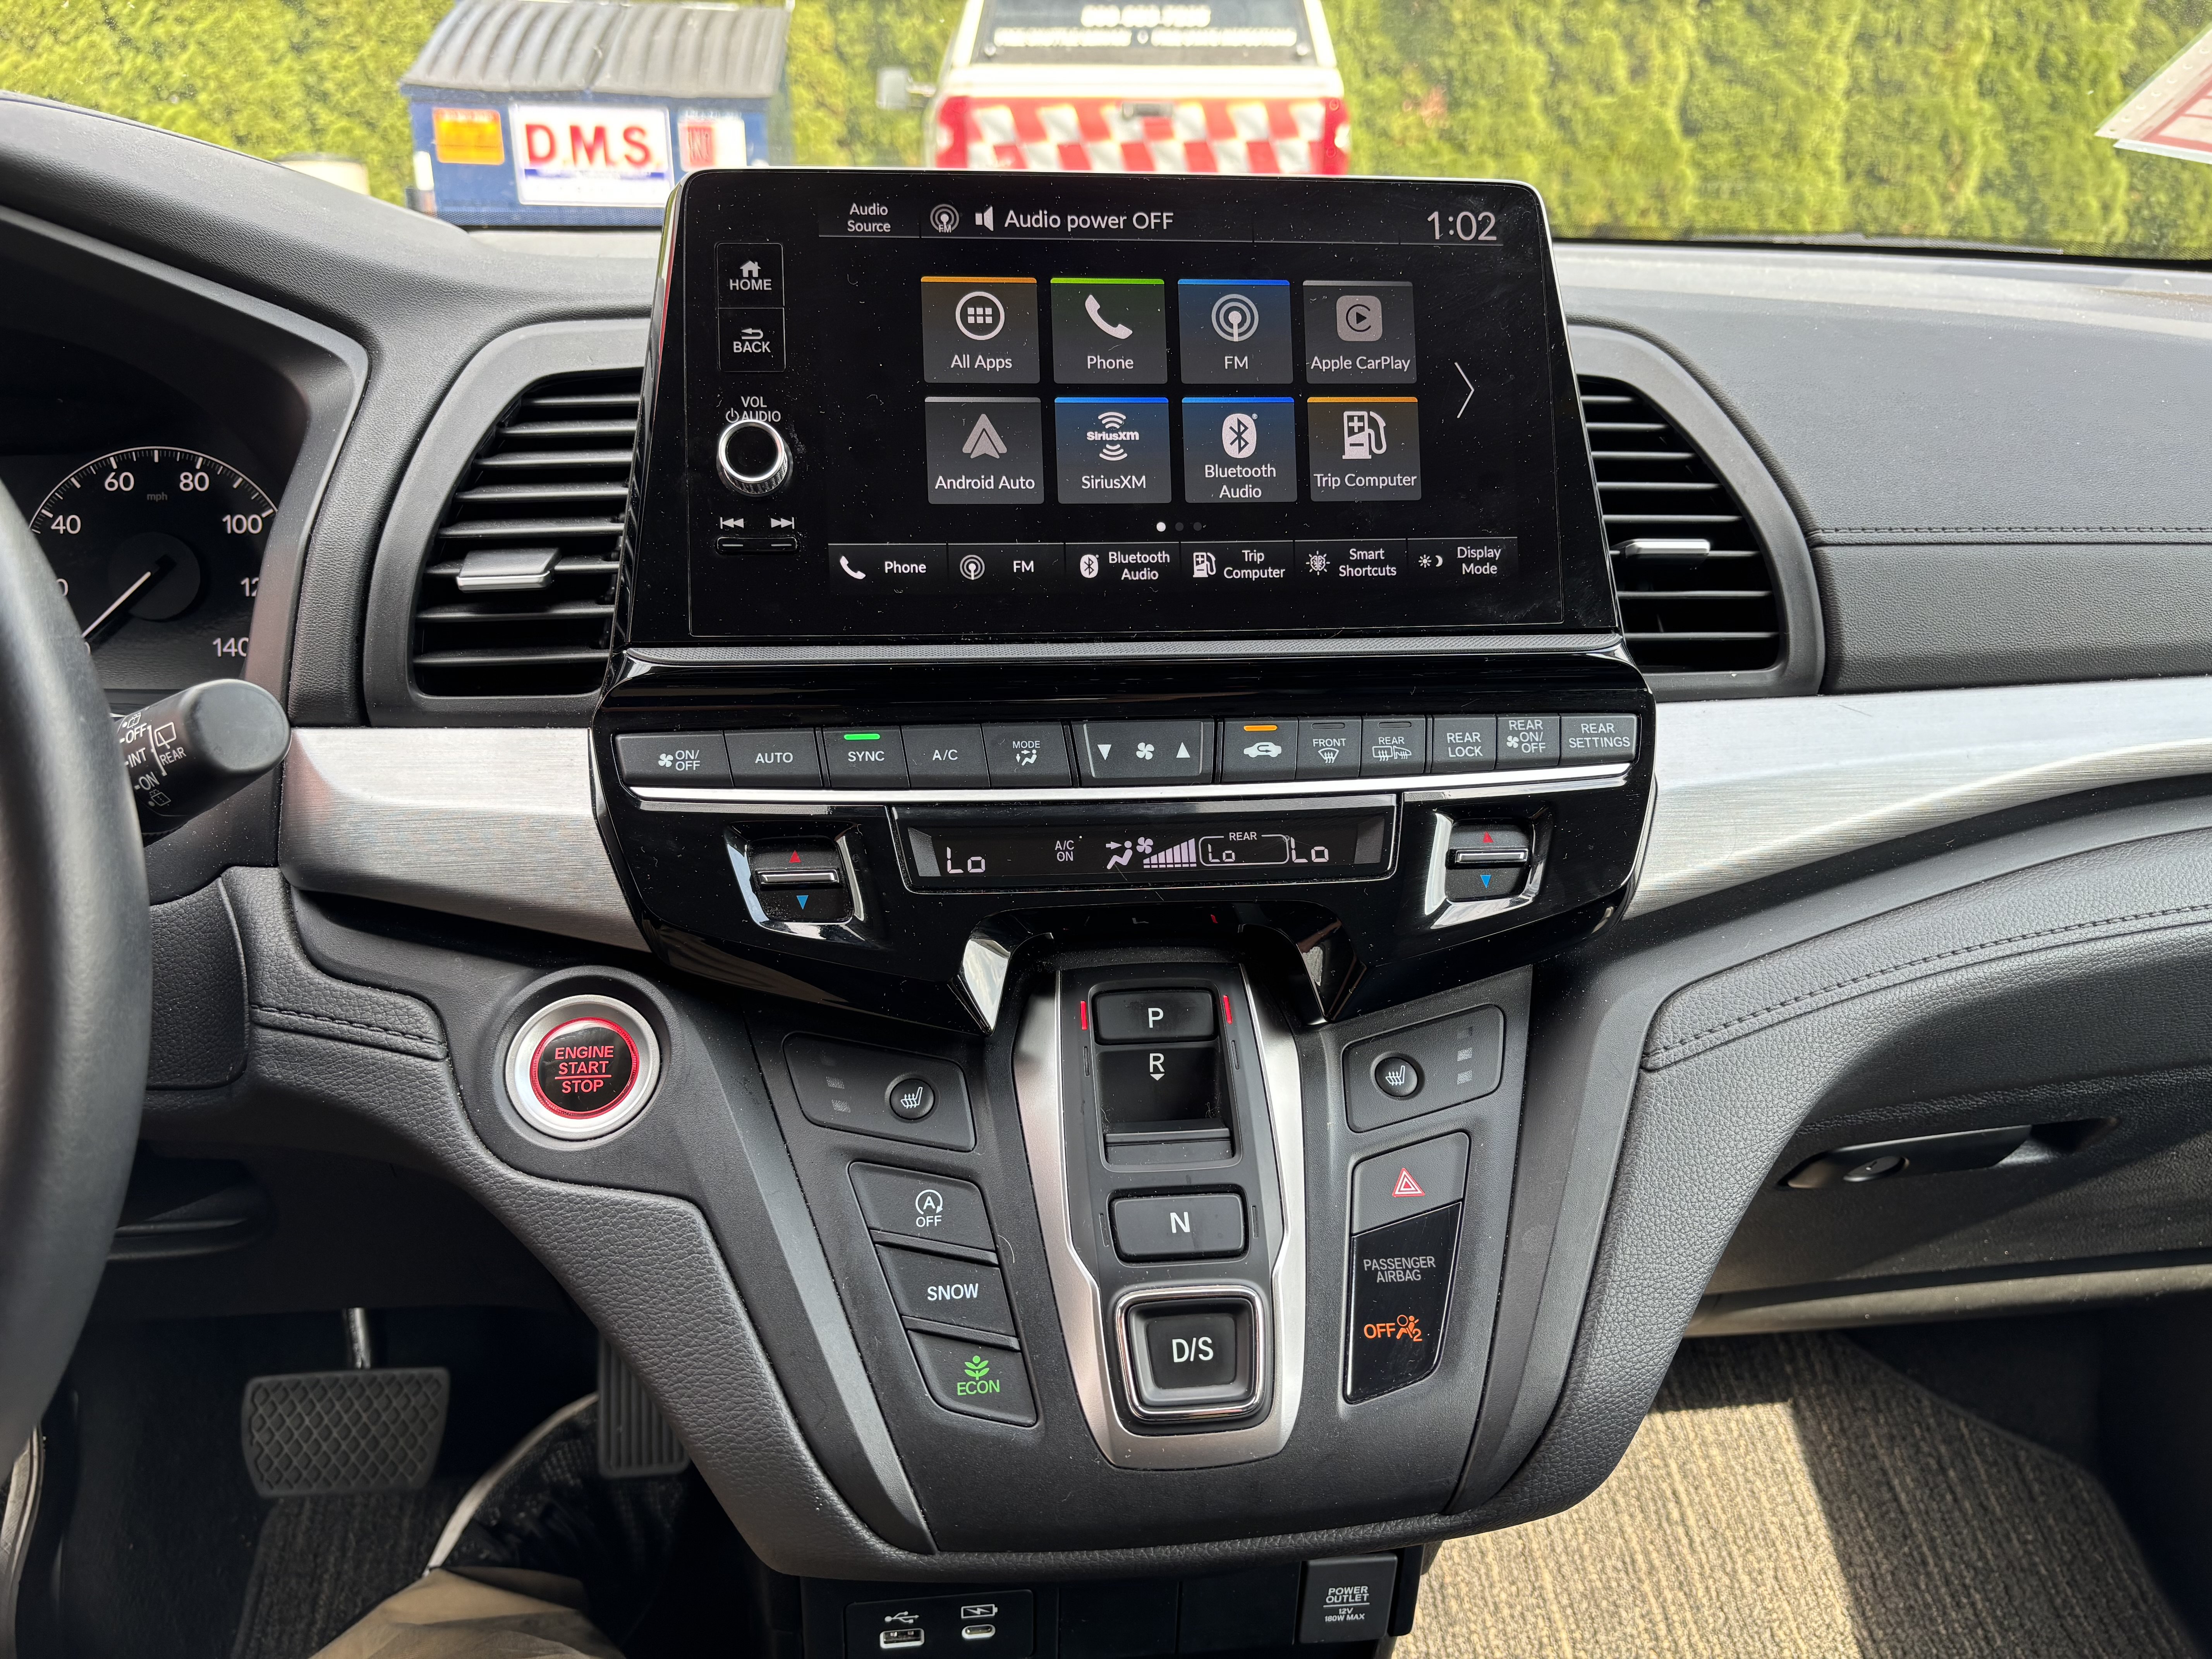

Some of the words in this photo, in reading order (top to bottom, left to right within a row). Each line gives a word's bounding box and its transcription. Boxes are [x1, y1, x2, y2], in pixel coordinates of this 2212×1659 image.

[850, 203, 888, 215] Audio
[847, 220, 891, 232] Source
[1004, 210, 1061, 228] Audio
[1067, 215, 1127, 232] power
[1133, 212, 1174, 230] OFF
[1427, 211, 1497, 240] 1:02
[730, 279, 772, 290] HOME
[733, 341, 771, 353] BACK
[951, 354, 970, 368] All
[974, 355, 1012, 372] Apps
[1087, 355, 1133, 369] Phone
[1224, 356, 1248, 369] FM
[1310, 356, 1352, 372] Apple
[1356, 356, 1410, 372] CarPlay
[741, 396, 767, 407] VOL
[742, 411, 781, 422] AUDIO
[1205, 464, 1276, 478] Bluetooth
[105, 472, 134, 491] 60
[179, 472, 209, 491] 80
[935, 475, 994, 489] Android
[998, 476, 1035, 489] Auto
[1082, 475, 1146, 489] SiriusXM
[1313, 473, 1341, 489] Trip
[1345, 474, 1417, 489] Computer
[147, 492, 167, 501] mph
[1219, 484, 1262, 498] Audio
[51, 515, 81, 534] 40
[222, 514, 262, 534] 100
[1109, 551, 1170, 563] Bluetooth
[1242, 550, 1264, 564] Trip
[1349, 548, 1385, 560] Smart
[1457, 546, 1501, 560] Display
[884, 560, 926, 573] Phone
[1013, 560, 1034, 572] FM
[1339, 564, 1397, 577] Shortcuts
[1462, 562, 1498, 575] Mode
[1121, 567, 1159, 580] Audio
[1223, 567, 1286, 581] Computer
[1508, 720, 1543, 730] REAR
[1581, 723, 1615, 734] REAR
[126, 723, 147, 743] OFF
[1446, 732, 1481, 743] REAR
[1520, 732, 1543, 742] ON/
[1013, 740, 1041, 749] MODE
[1313, 738, 1346, 747] FRONT
[1521, 742, 1546, 753] OFF
[1569, 737, 1630, 748] SETTINGS
[128, 748, 147, 768] INT
[160, 747, 187, 765] REAR
[676, 750, 699, 760] ON/
[755, 752, 793, 764] AUTO
[848, 750, 885, 762] SYNC
[932, 749, 958, 761] A/C
[1448, 746, 1483, 757] LOCK
[675, 760, 701, 771] OFF
[139, 772, 160, 790] ON
[1229, 831, 1257, 841] REAR
[1055, 840, 1074, 850] A/C
[1057, 851, 1073, 862] ON
[1148, 1008, 1164, 1028] P
[555, 1046, 614, 1060] ENGINE
[559, 1061, 609, 1075] START
[1149, 1053, 1165, 1072] R
[562, 1080, 604, 1093] STOP
[916, 1215, 942, 1228] OFF
[1170, 1212, 1190, 1233] N
[1364, 1256, 1436, 1271] PASSENGER
[1377, 1269, 1421, 1283] AIRBAG
[927, 1283, 979, 1301] SNOW
[1364, 1323, 1395, 1339] OFF
[1172, 1337, 1214, 1363] D/S
[957, 1379, 1000, 1396] ECON
[1328, 1586, 1368, 1595] POWER
[1326, 1593, 1369, 1603] OUTLET
